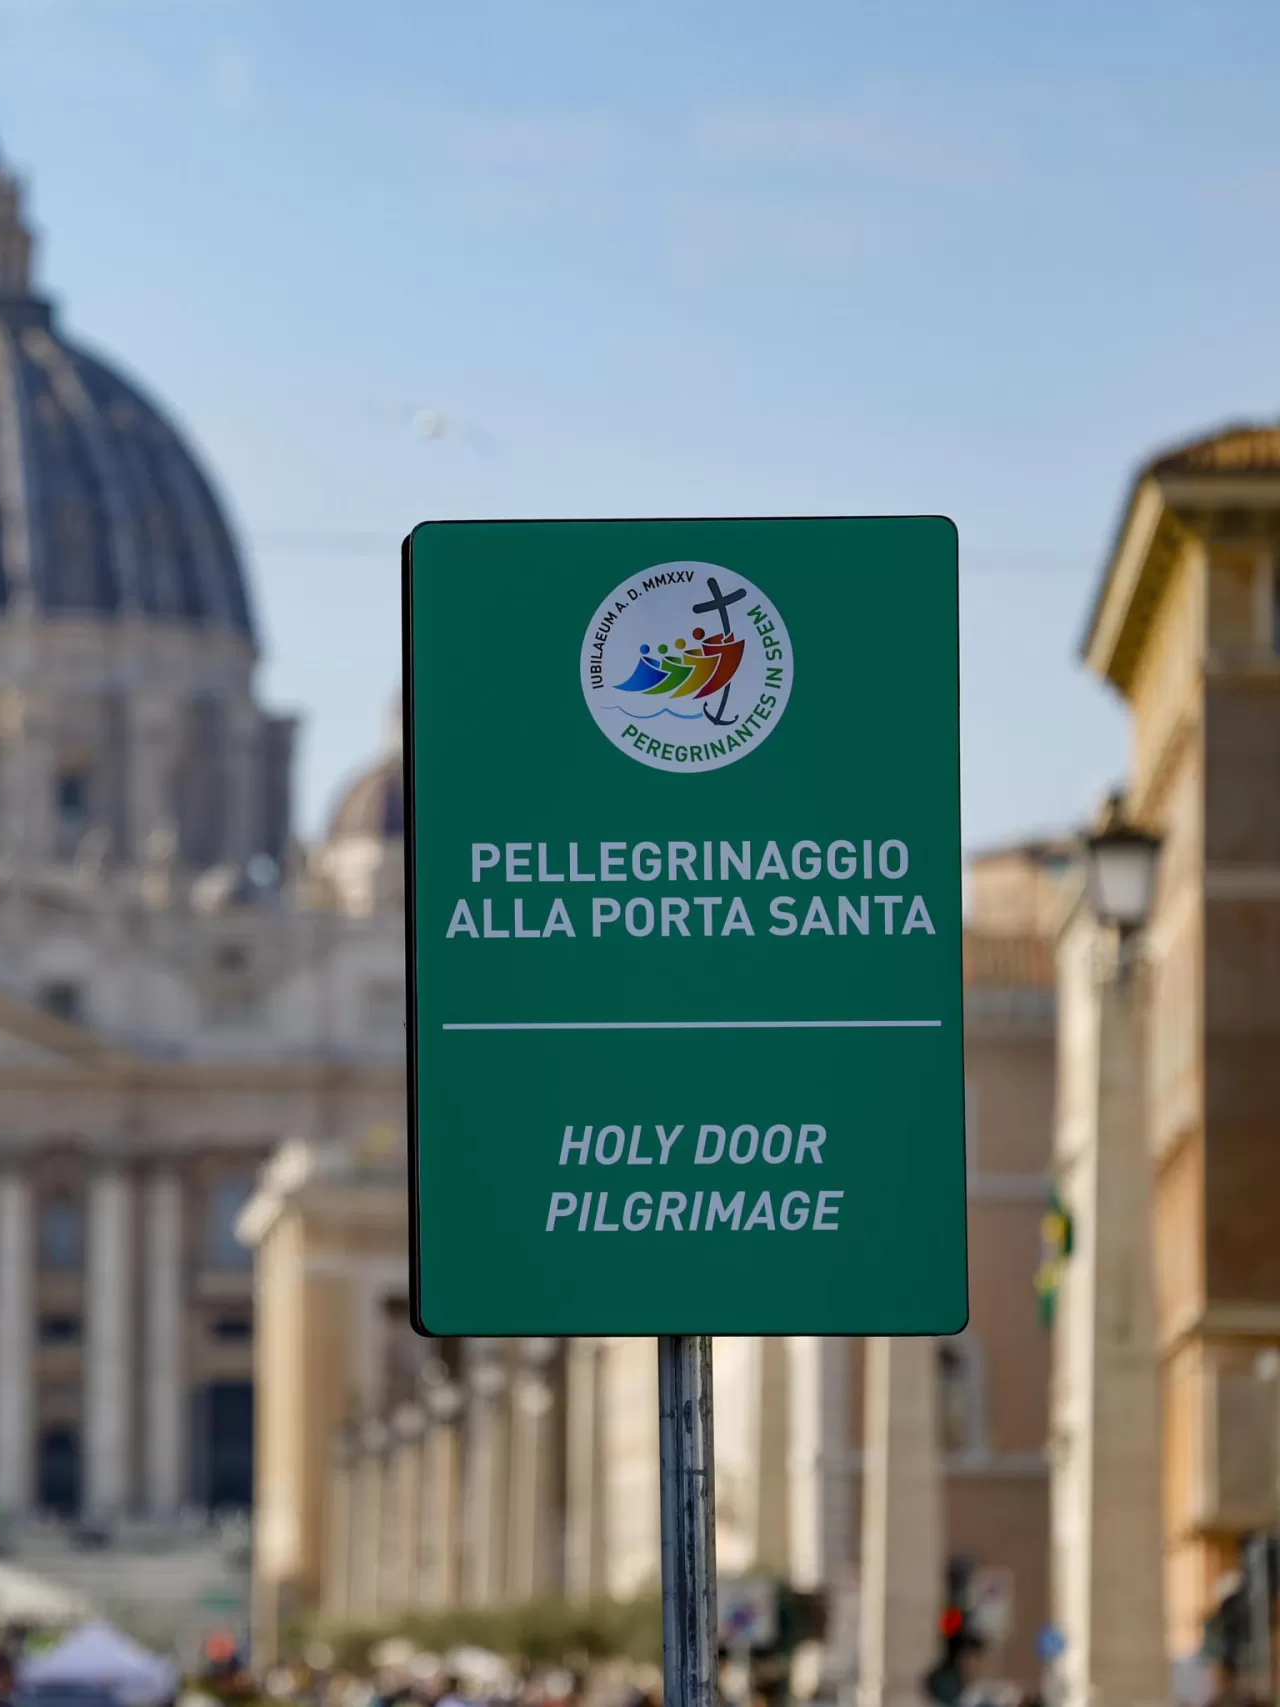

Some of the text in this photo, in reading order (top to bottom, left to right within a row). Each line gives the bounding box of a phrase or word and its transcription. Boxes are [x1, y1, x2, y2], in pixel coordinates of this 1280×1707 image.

[590, 610, 618, 689] IUBILAEUM
[642, 570, 695, 592] MMXXV
[621, 604, 784, 763] PEREGRINANTES IN SPEM
[471, 839, 910, 883] PELLEGRINAGGIO
[445, 894, 936, 939] ALLA PORTA SANTA
[558, 1123, 828, 1165] HOLY DOOR
[545, 1189, 845, 1232] PILGRIMAGE
